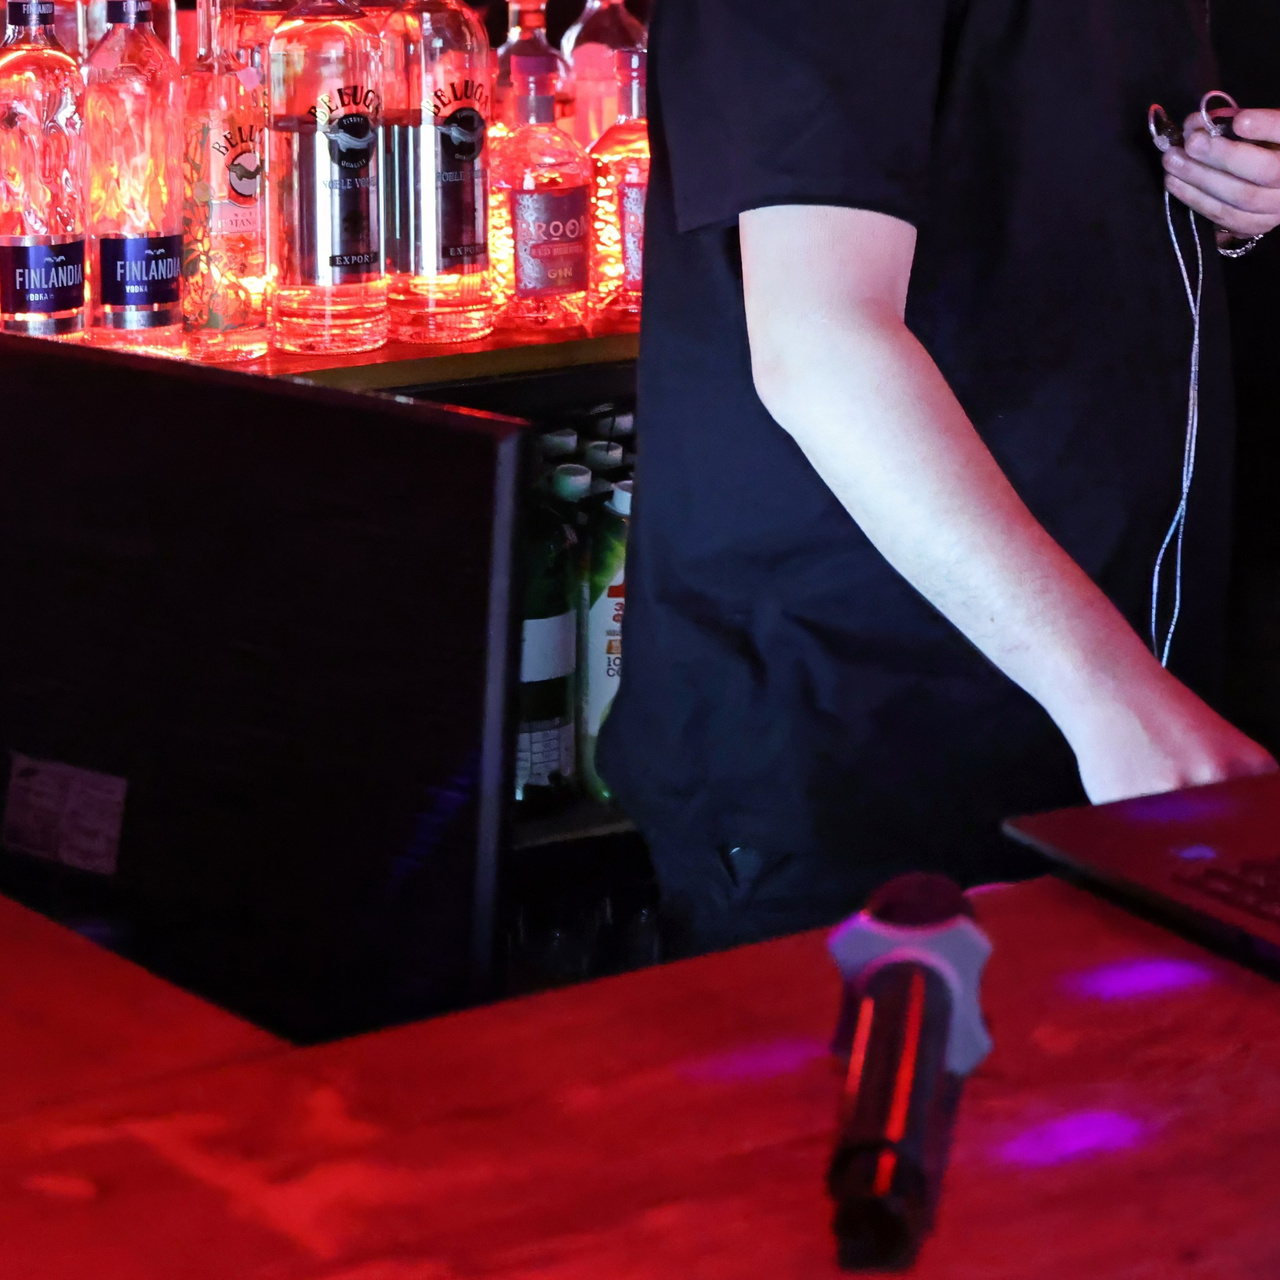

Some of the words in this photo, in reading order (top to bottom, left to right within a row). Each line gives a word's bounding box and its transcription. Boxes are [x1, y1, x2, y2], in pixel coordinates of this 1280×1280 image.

[15, 263, 83, 291] FINLANDIA
[116, 256, 182, 282] FINLANDIA
[125, 283, 149, 294] VODKA
